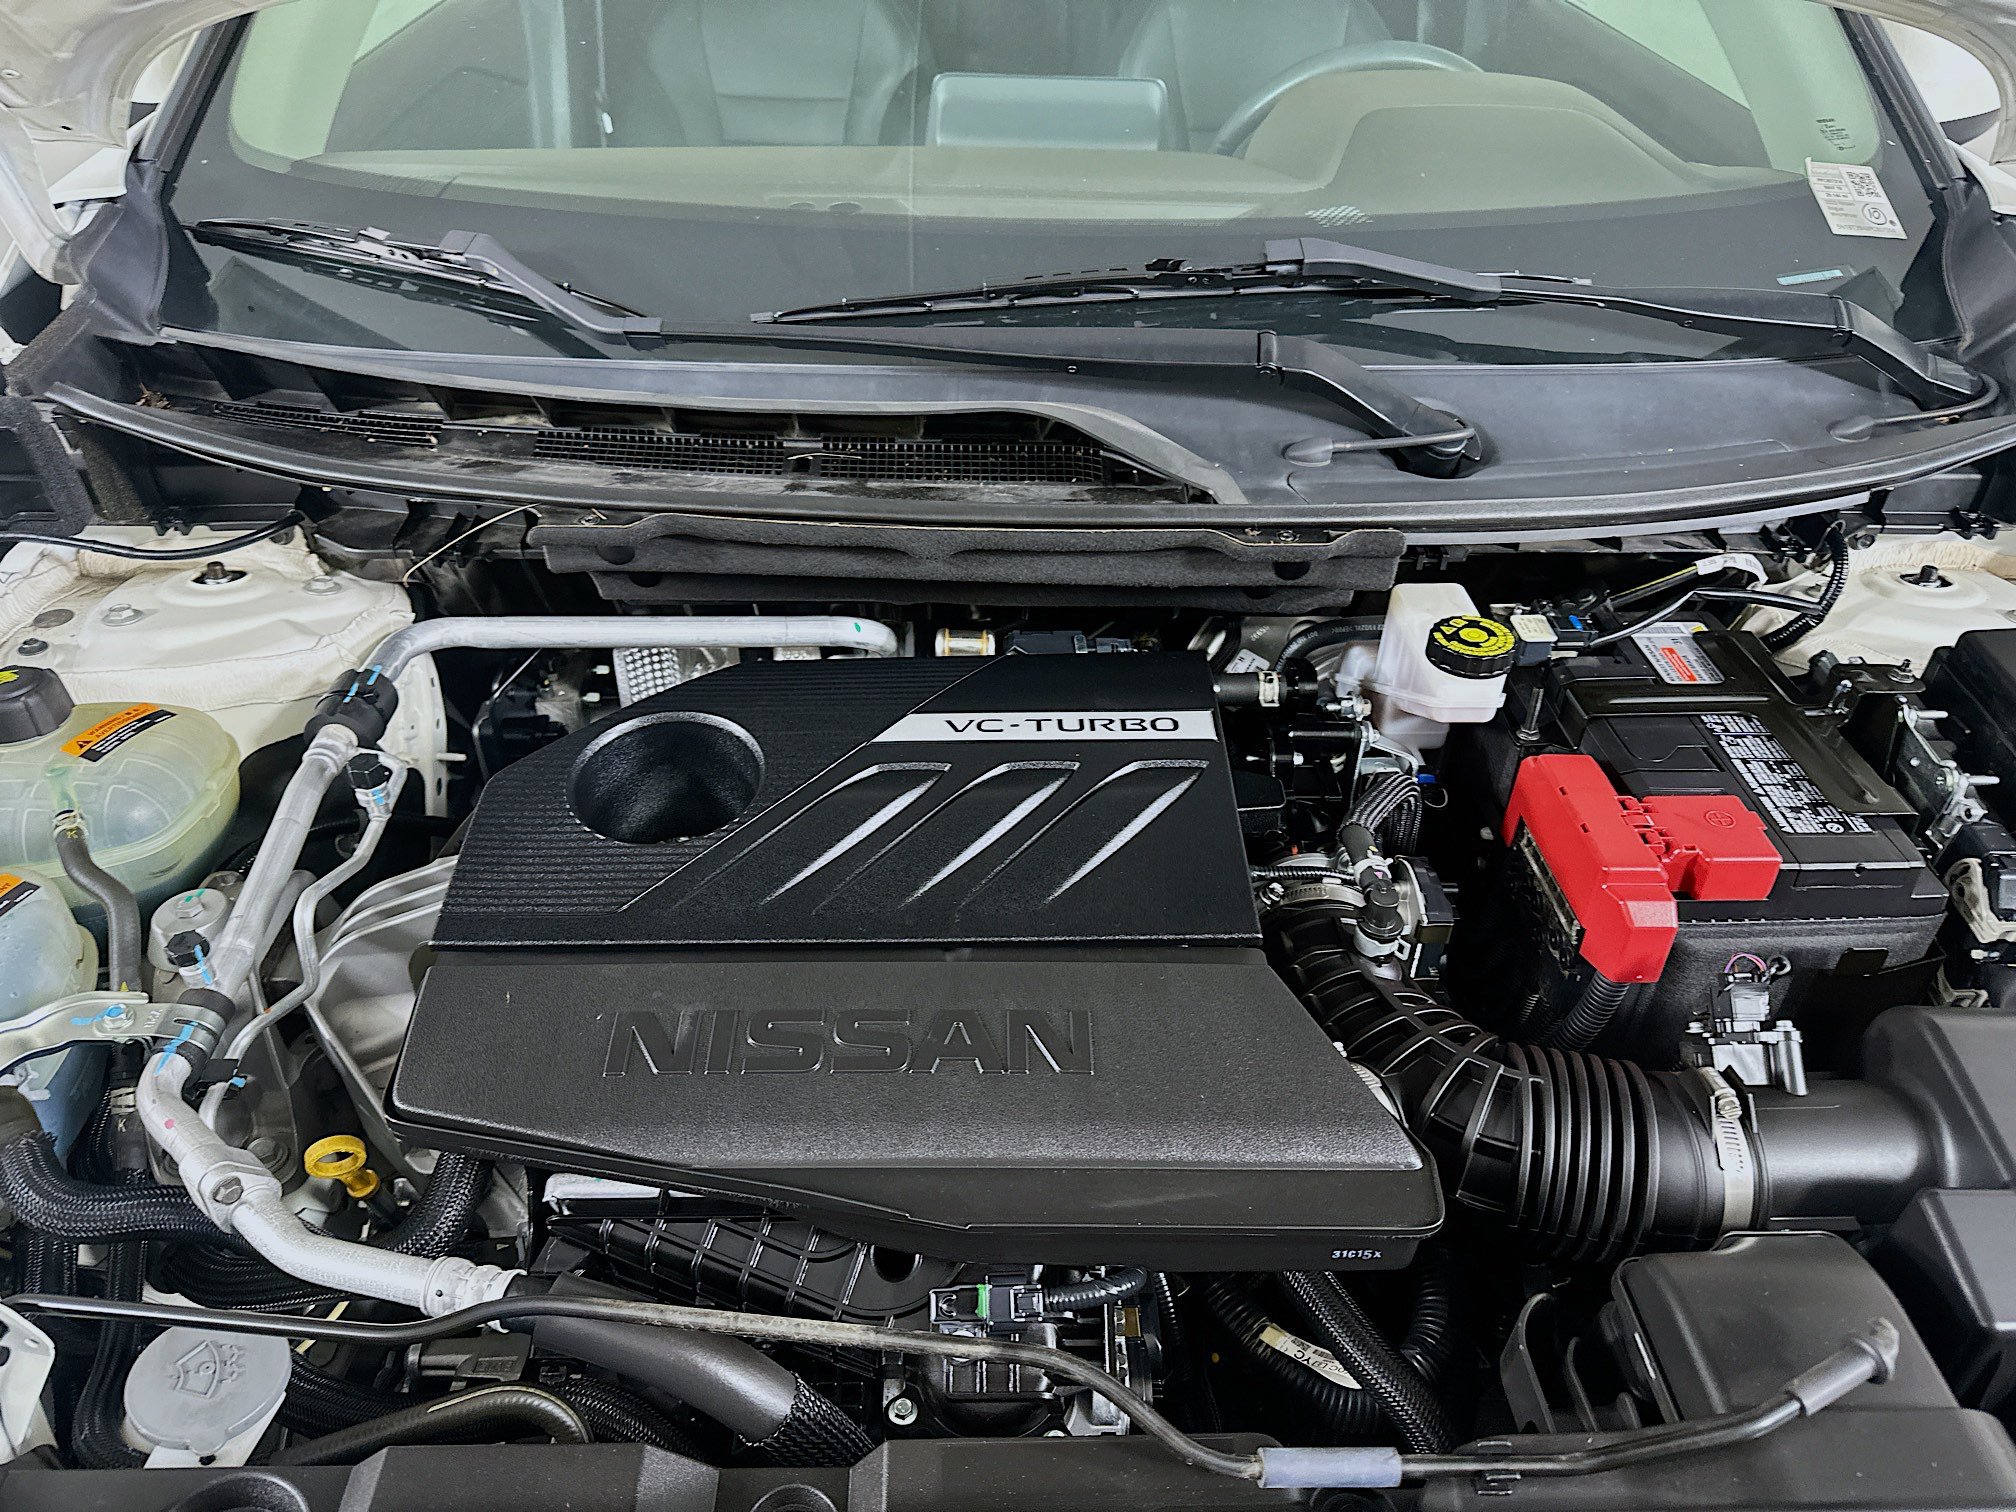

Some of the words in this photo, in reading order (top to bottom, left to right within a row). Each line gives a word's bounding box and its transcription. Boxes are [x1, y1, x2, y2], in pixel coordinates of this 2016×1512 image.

[945, 717, 1180, 733] VC-TURBO
[602, 1008, 1096, 1078] NISSAN
[117, 1117, 127, 1132] K
